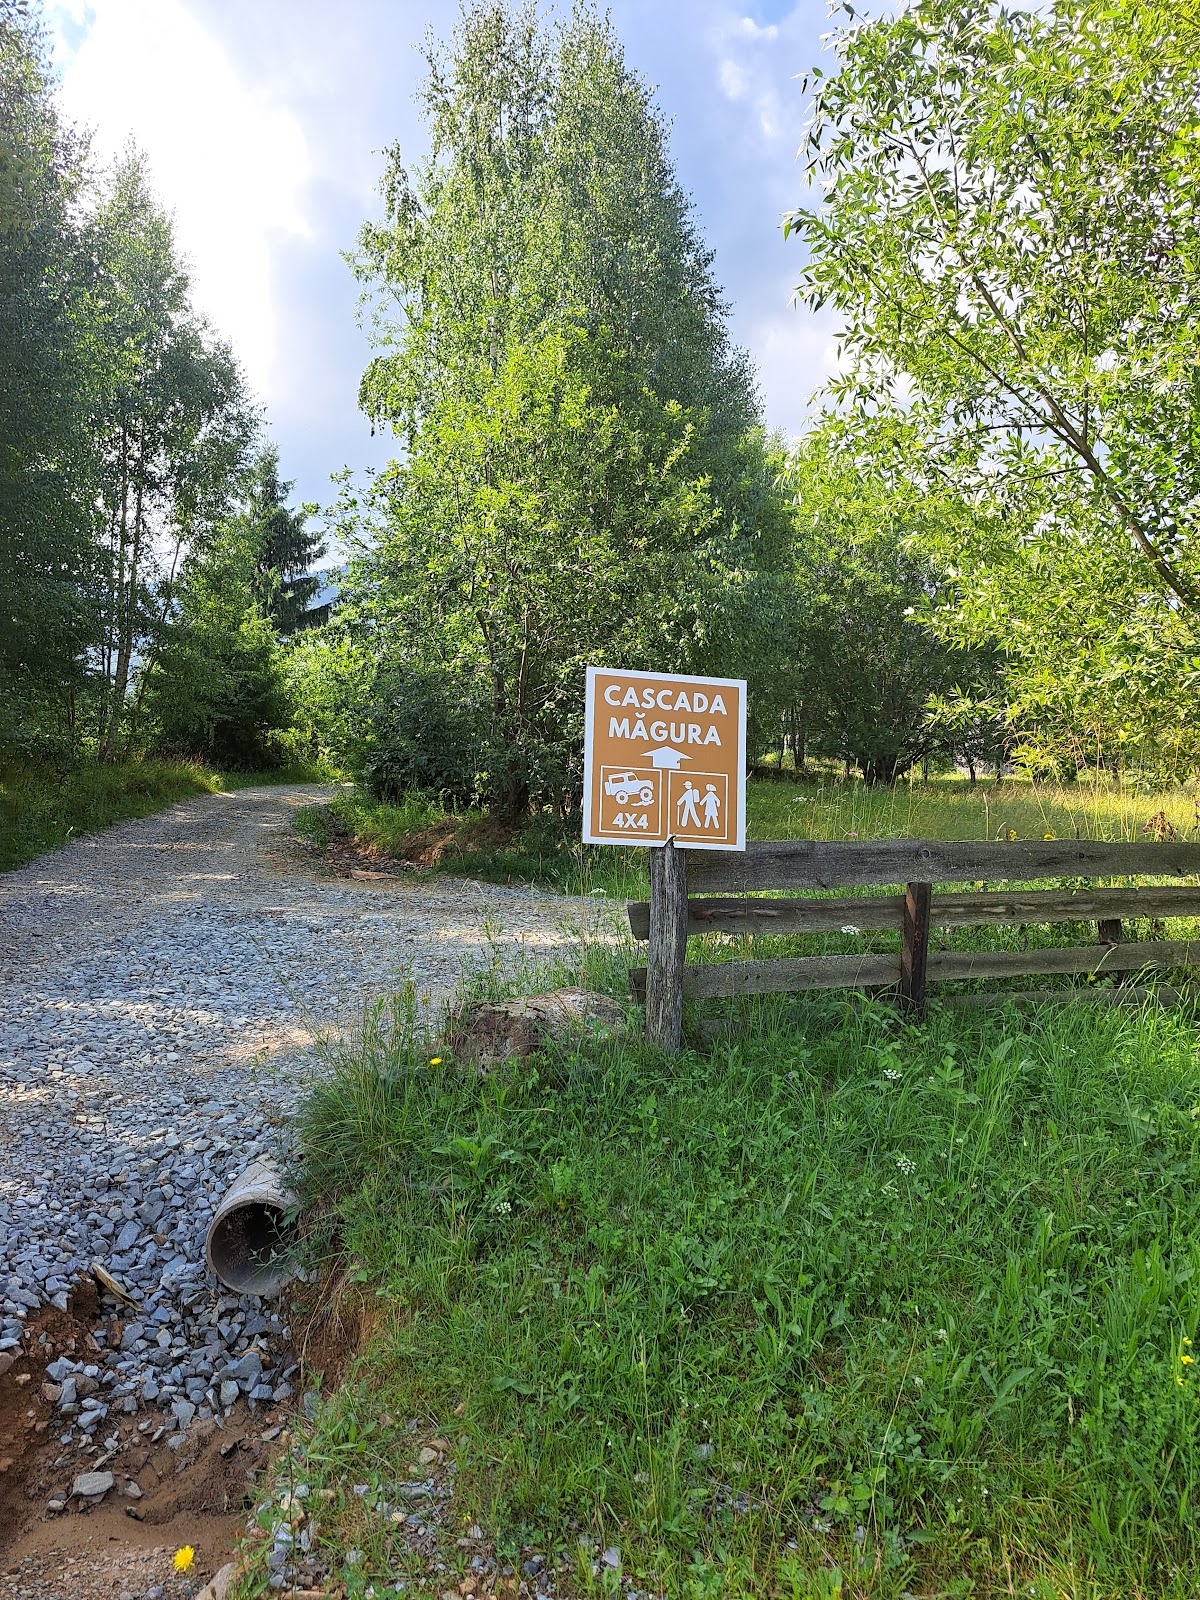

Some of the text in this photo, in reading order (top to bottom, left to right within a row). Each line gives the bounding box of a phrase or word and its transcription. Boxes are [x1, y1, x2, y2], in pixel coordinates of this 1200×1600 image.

[604, 684, 728, 716] CASCADA
[608, 711, 722, 747] MĂGURA
[612, 812, 649, 830] 4X4
